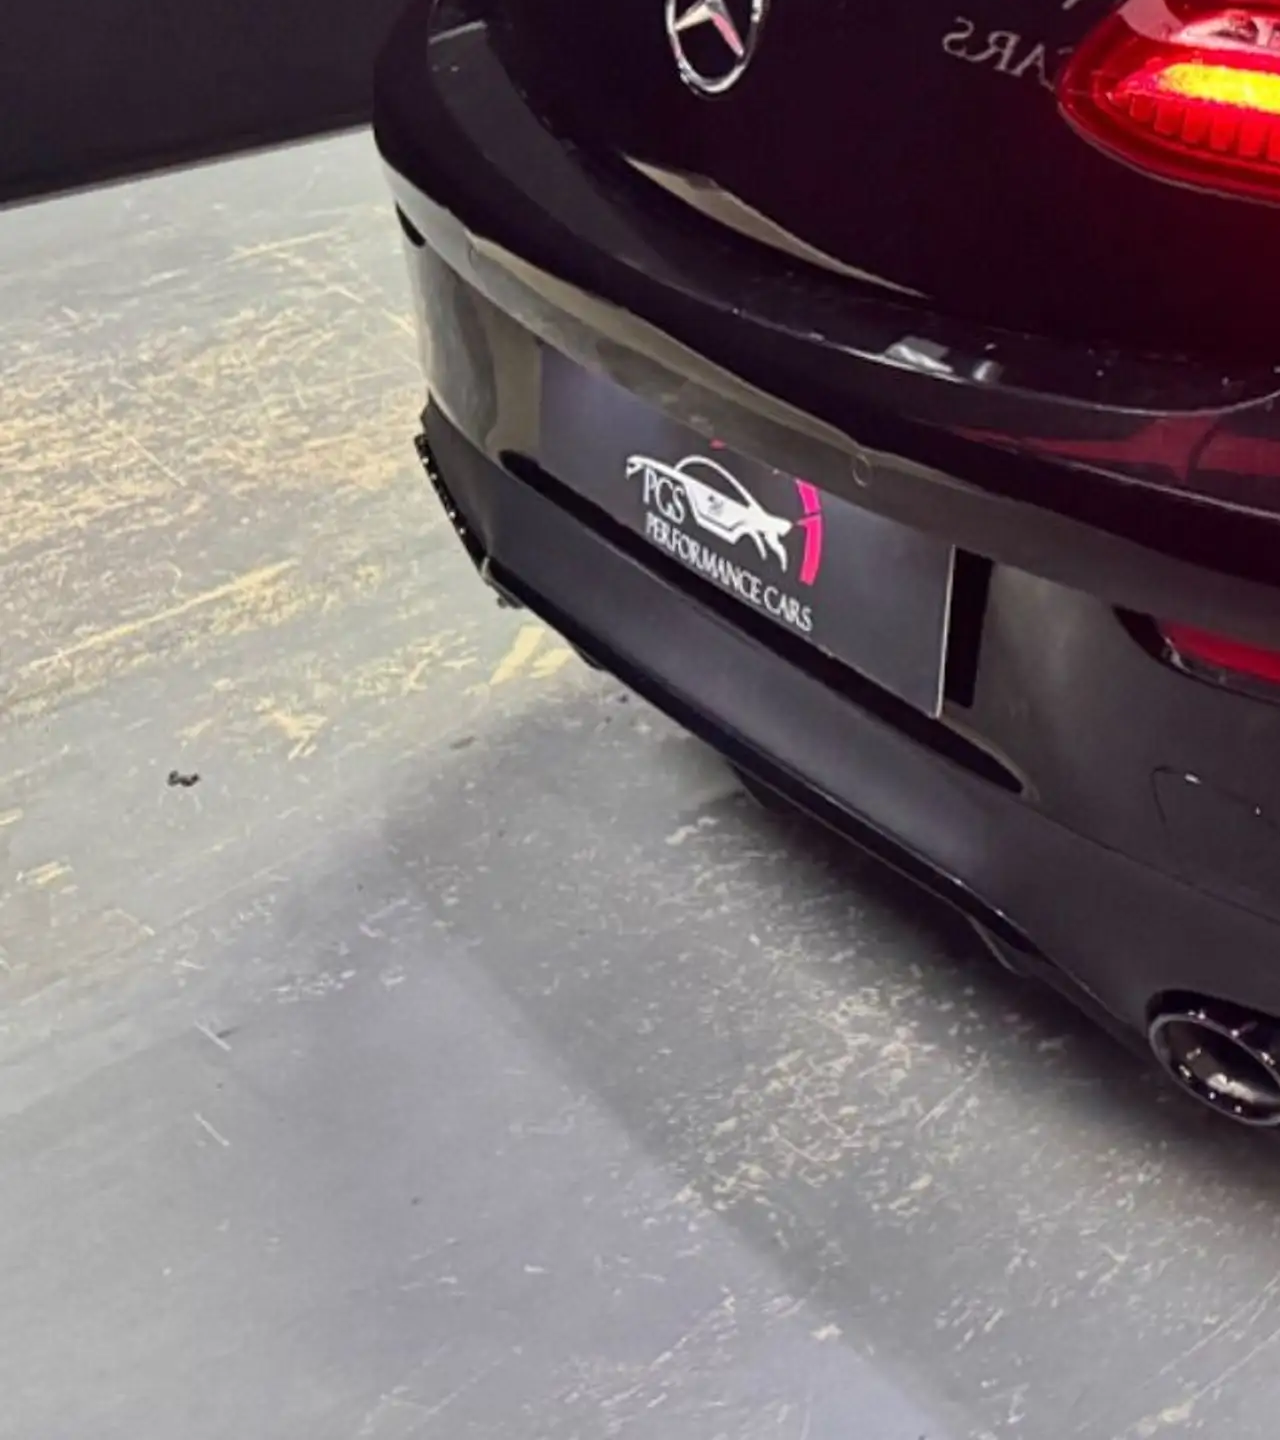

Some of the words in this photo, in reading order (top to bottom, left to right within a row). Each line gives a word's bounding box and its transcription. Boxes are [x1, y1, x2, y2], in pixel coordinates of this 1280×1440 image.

[643, 465, 688, 525] PGS
[645, 511, 763, 604] PERFORMANCE
[763, 586, 813, 632] CARS
